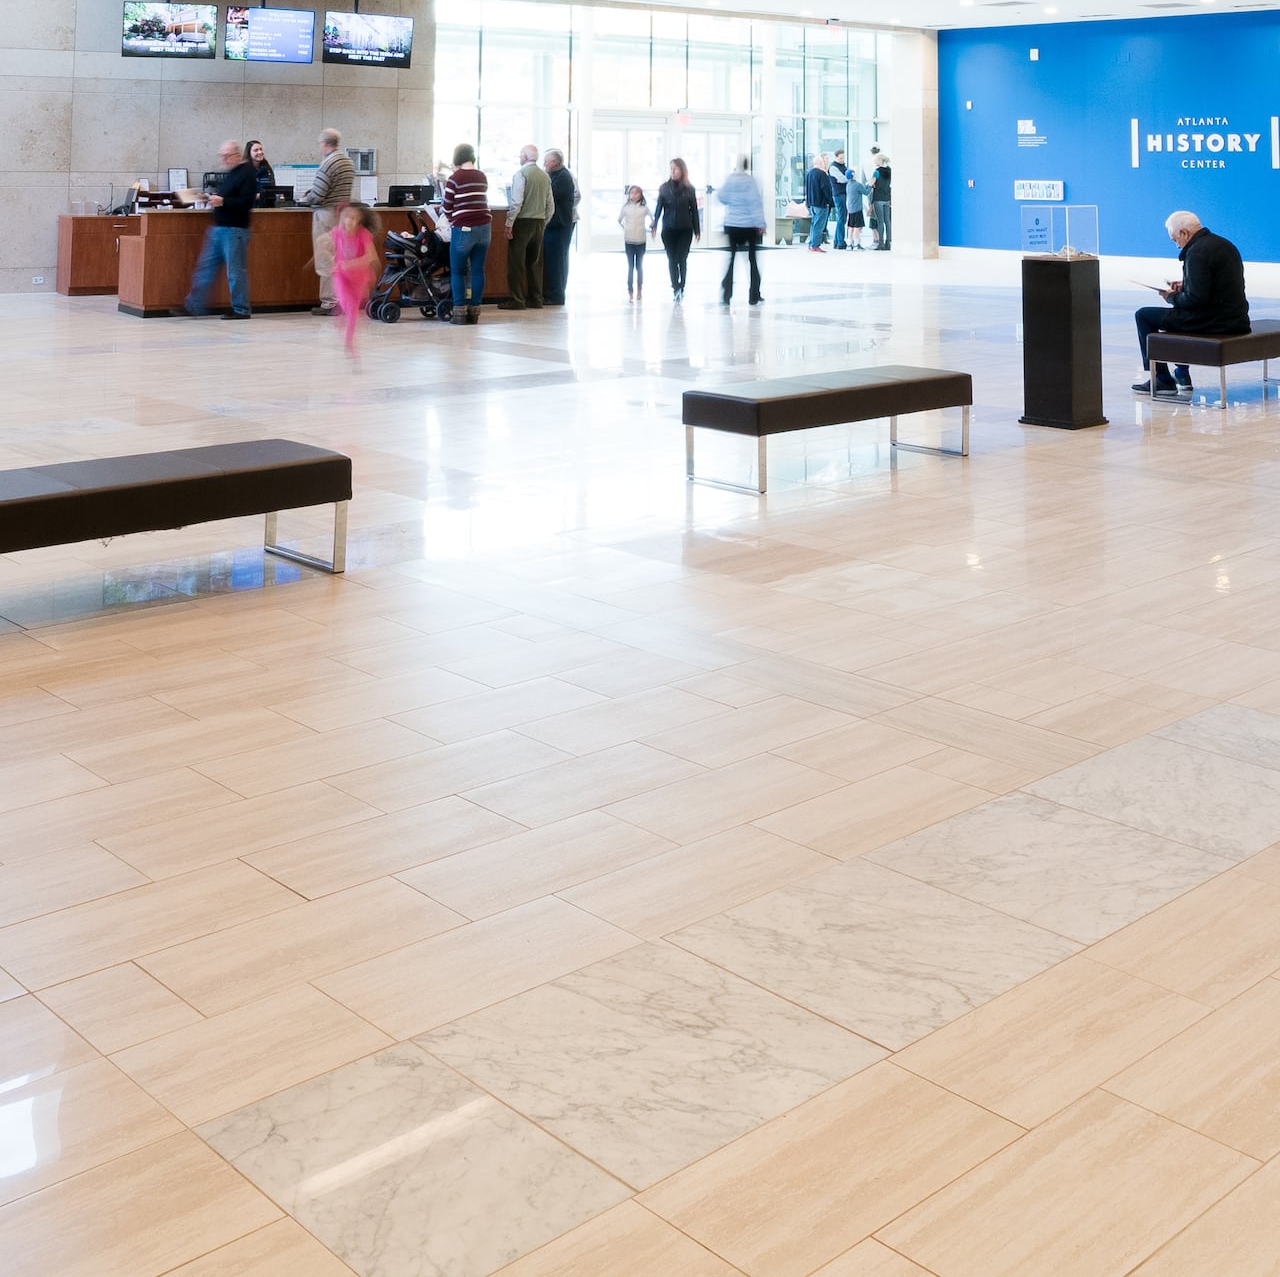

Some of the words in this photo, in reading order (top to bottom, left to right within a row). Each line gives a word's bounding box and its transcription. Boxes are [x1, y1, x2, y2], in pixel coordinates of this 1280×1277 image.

[1177, 117, 1229, 126] ATLANTA
[1146, 134, 1261, 152] HISTORY
[1181, 160, 1226, 169] CENTER
